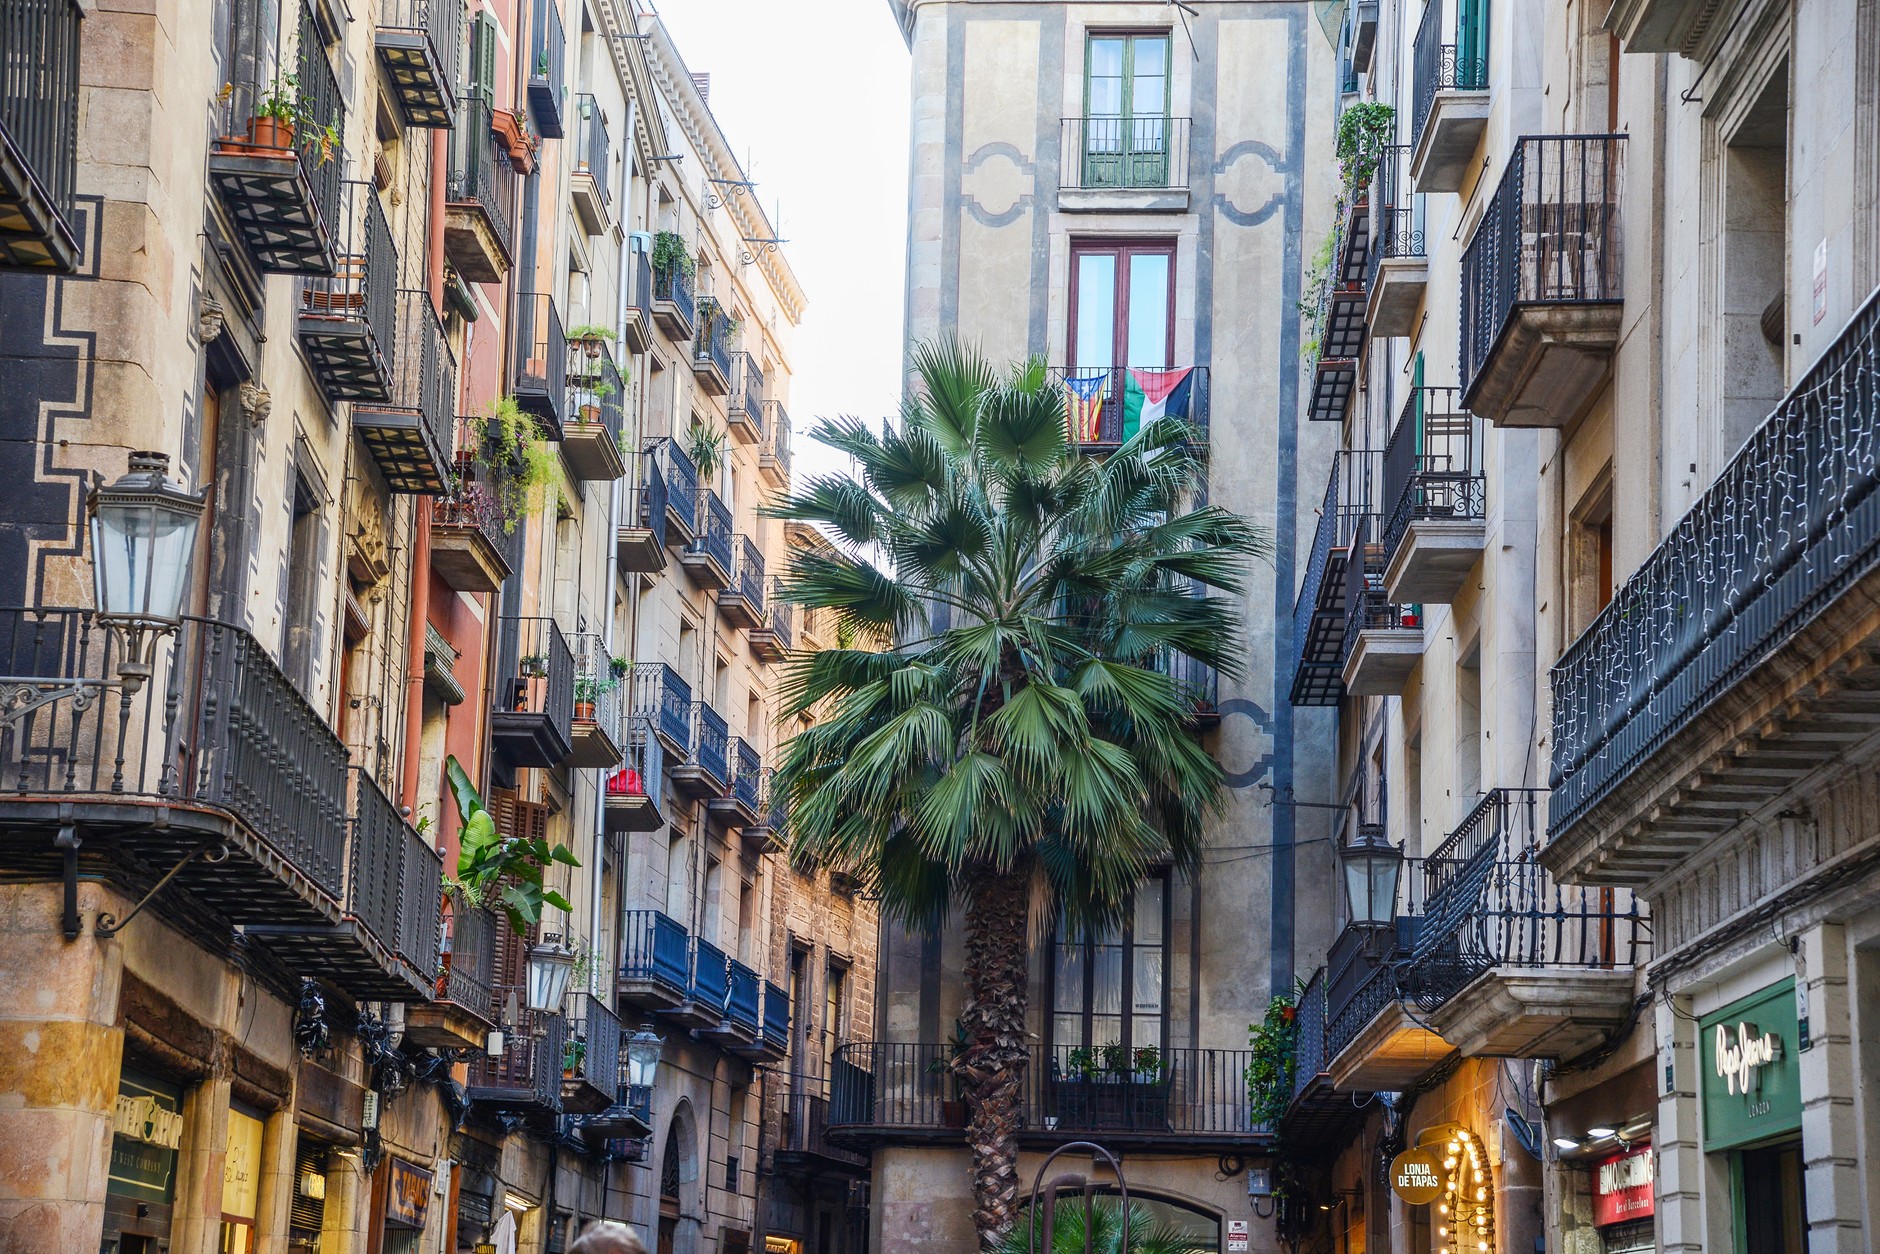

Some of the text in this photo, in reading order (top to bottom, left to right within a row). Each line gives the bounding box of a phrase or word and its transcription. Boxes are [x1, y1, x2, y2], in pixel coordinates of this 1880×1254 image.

[1716, 1021, 1773, 1096] Pepe Jeans
[1748, 1100, 1770, 1118] LONDON
[1404, 1163, 1431, 1175] LONJA
[1398, 1175, 1438, 1187] DE TAPAS
[1628, 1196, 1649, 1211] Barcelona
